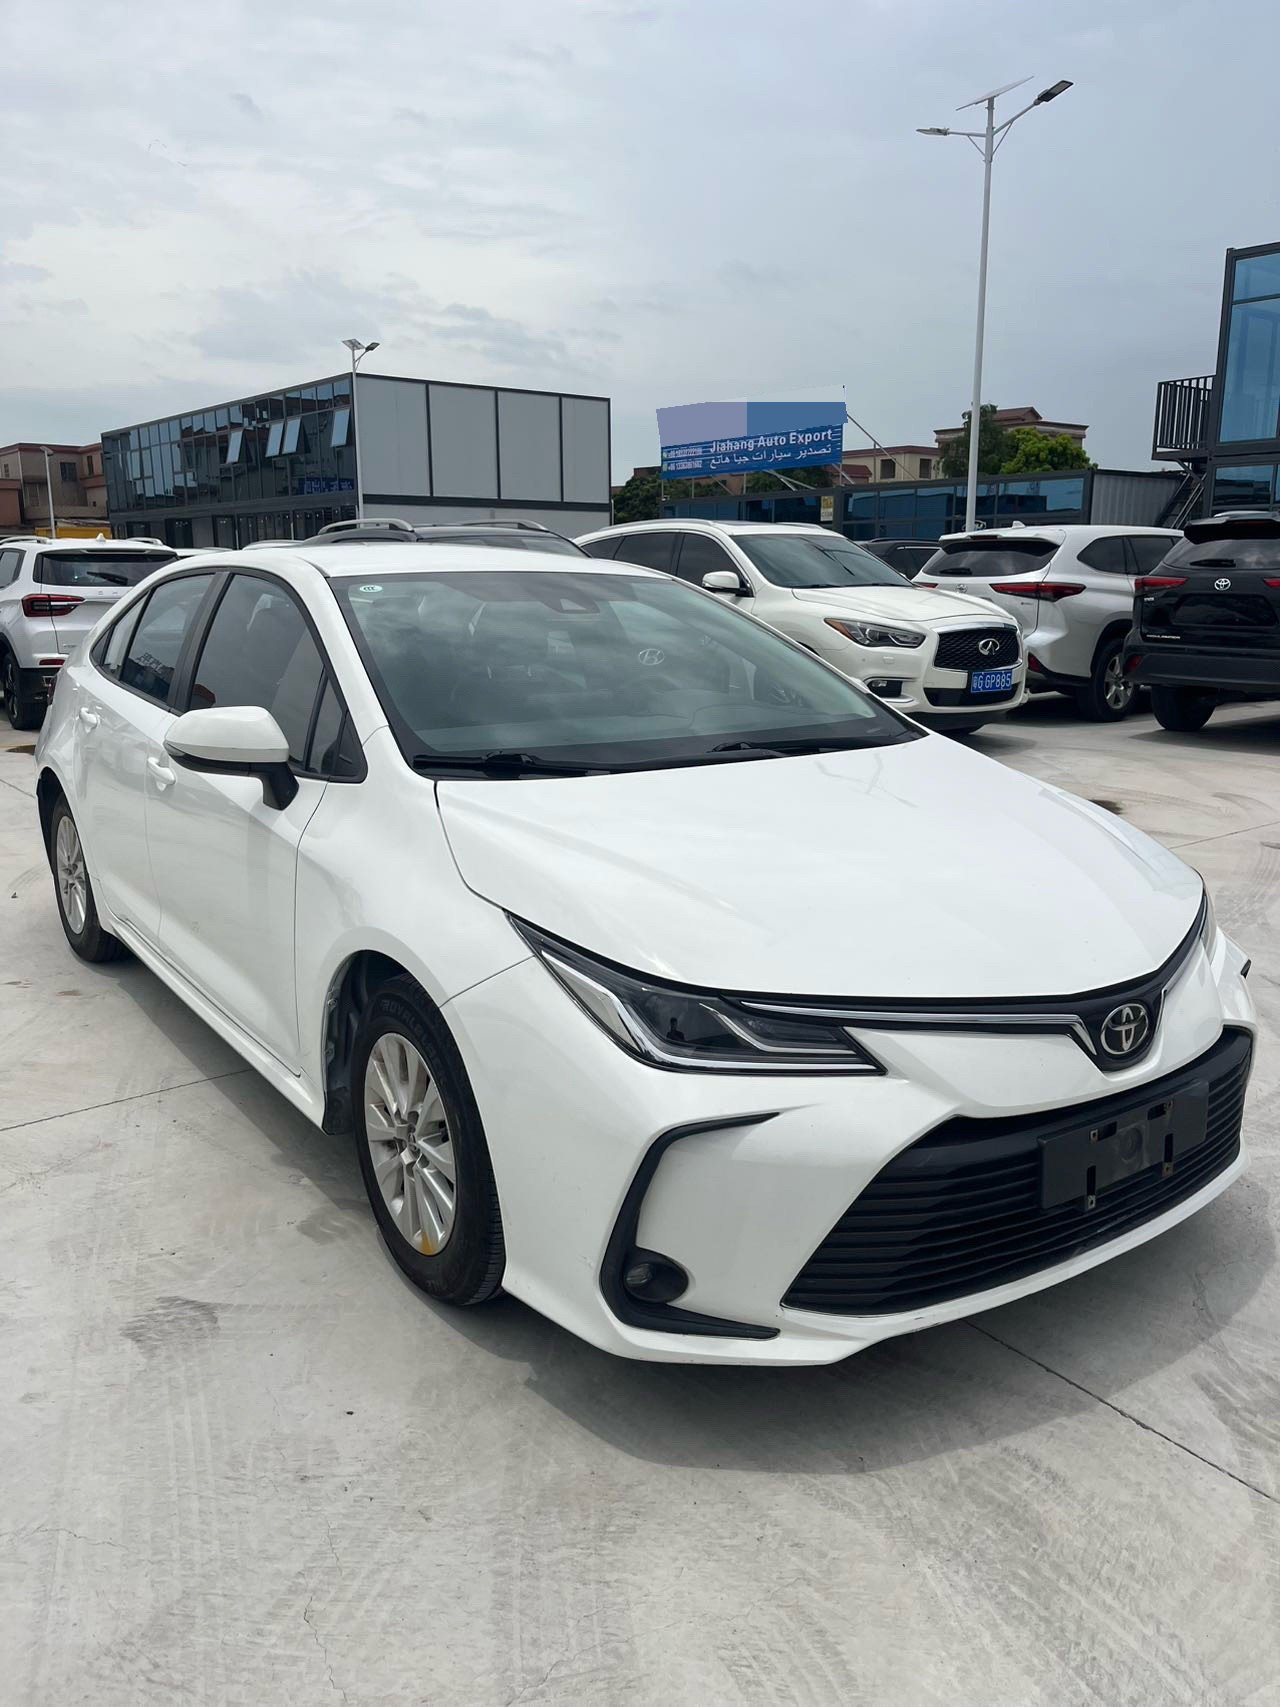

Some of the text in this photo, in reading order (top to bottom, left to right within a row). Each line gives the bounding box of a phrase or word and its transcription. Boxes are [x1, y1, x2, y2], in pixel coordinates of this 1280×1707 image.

[710, 439, 754, 453] Jiahang
[758, 435, 787, 447] Auto
[789, 429, 833, 445] Export
[752, 448, 792, 463] سيارات
[795, 443, 831, 460] تصدير
